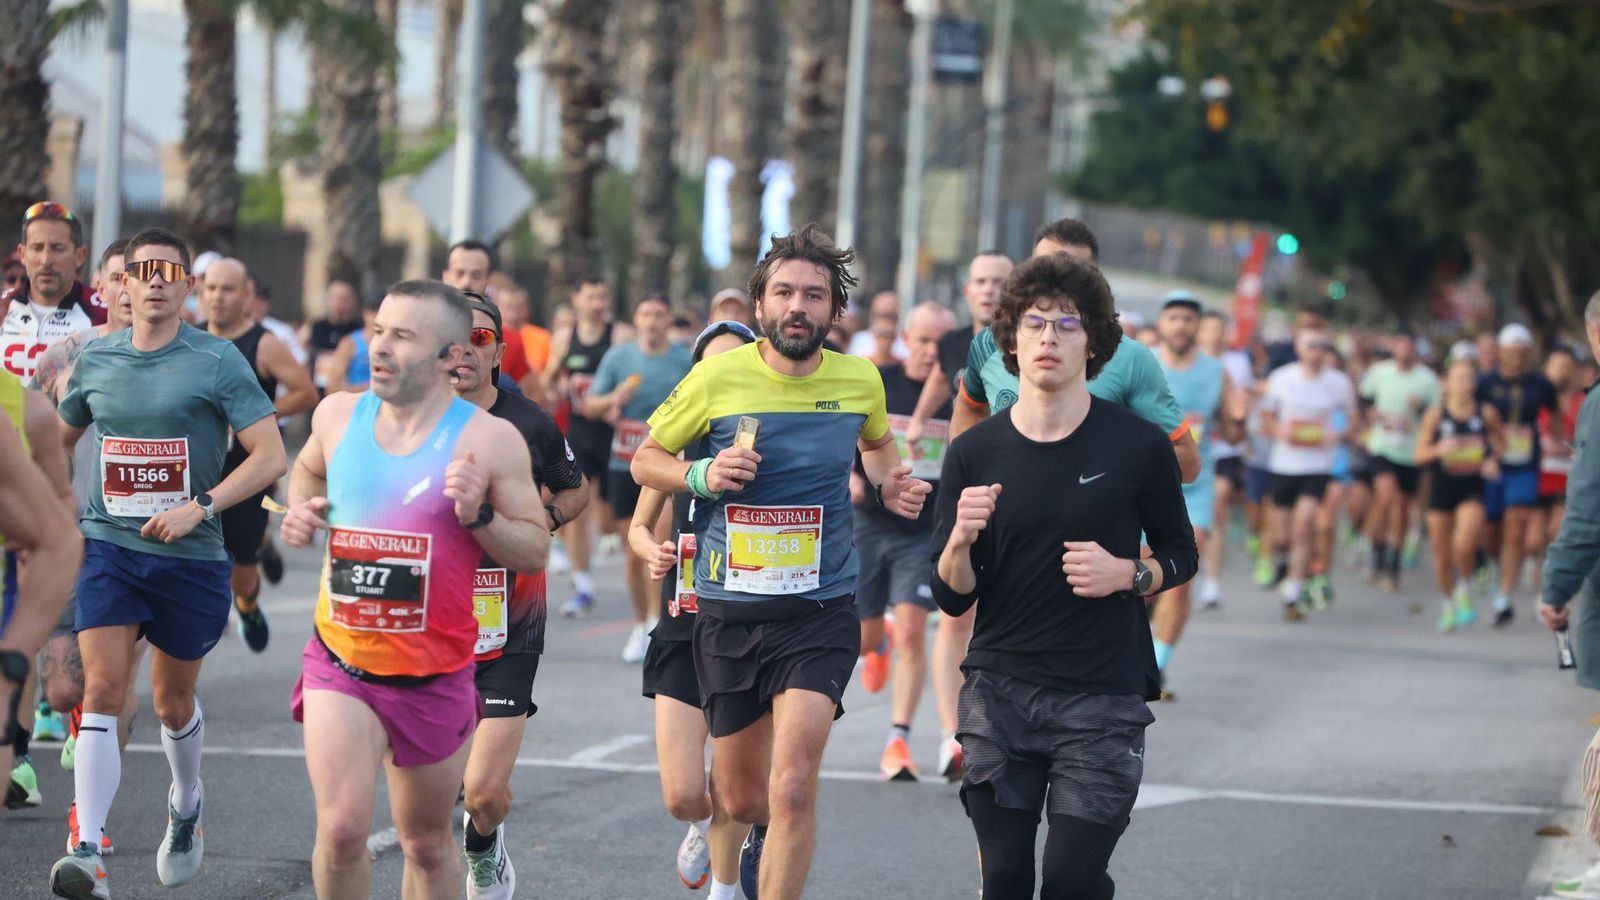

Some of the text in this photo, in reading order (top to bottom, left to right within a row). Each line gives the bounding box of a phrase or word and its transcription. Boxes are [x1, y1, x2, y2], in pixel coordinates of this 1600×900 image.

[122, 443, 180, 455] GENERALI
[118, 467, 169, 483] 11566
[750, 510, 814, 524] GENERALI
[348, 533, 422, 553] GENERALI
[745, 538, 800, 554] 13258
[351, 565, 391, 586] 377
[473, 574, 499, 586] RALI
[355, 585, 385, 595] STUART
[476, 601, 486, 615] 3
